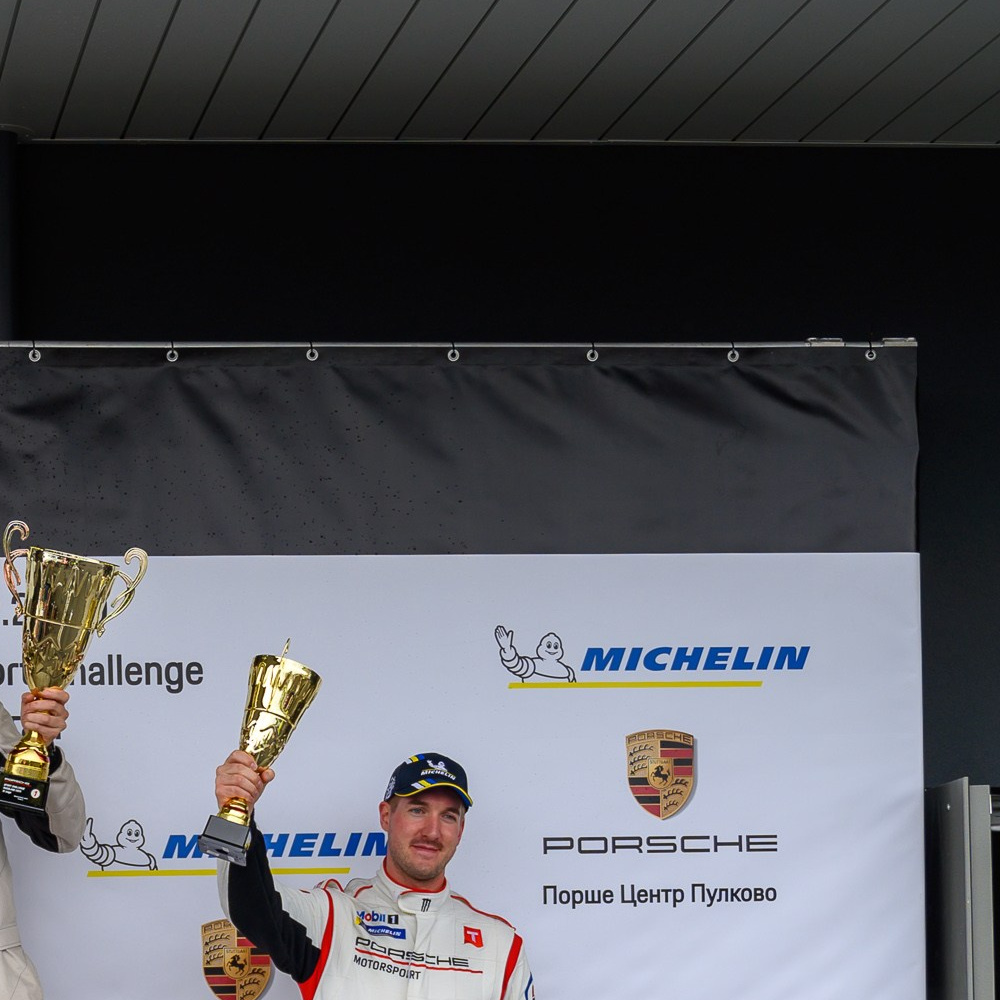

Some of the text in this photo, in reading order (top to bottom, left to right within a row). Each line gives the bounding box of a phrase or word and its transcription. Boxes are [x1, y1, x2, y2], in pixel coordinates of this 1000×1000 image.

[581, 646, 809, 672] MICHELIN
[543, 835, 777, 854] PORSCHE
[543, 884, 776, 909] Порше Центр Пулково
